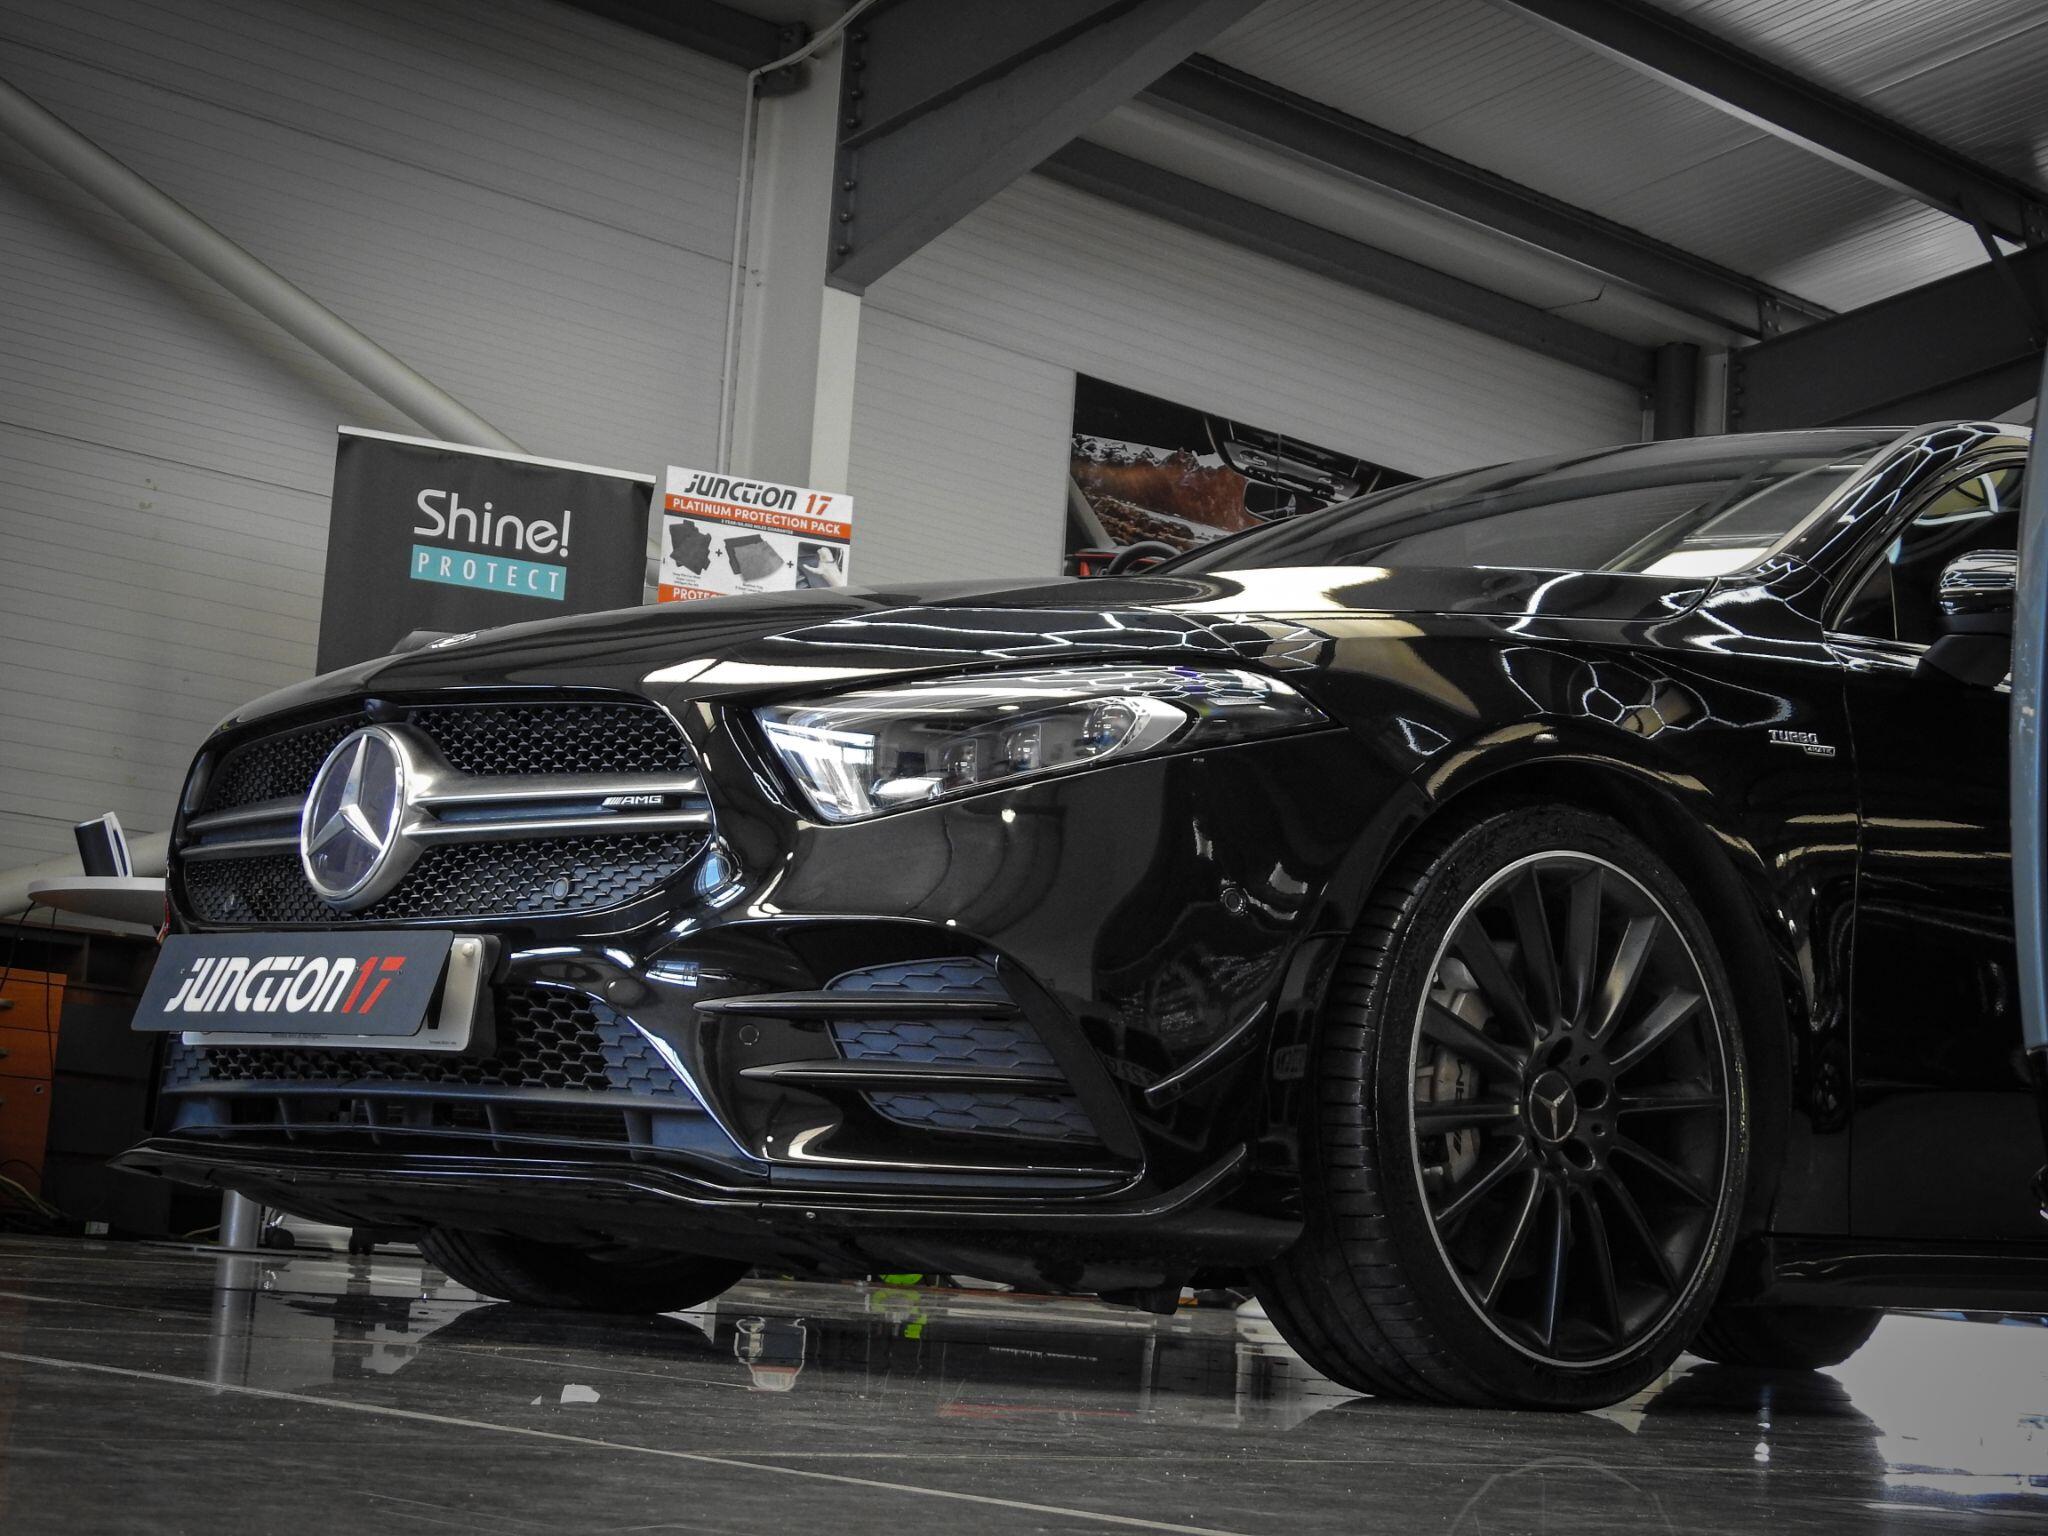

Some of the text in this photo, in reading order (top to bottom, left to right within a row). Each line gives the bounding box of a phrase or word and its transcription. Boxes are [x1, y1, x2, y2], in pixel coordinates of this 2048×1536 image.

[684, 474, 833, 516] JUNCTION 17
[413, 488, 571, 558] Shine!
[672, 497, 841, 535] PLATINUM PROTECTION PACK
[418, 552, 560, 593] PROTECT
[1767, 729, 1819, 745] TURBO
[620, 795, 662, 805] AMG
